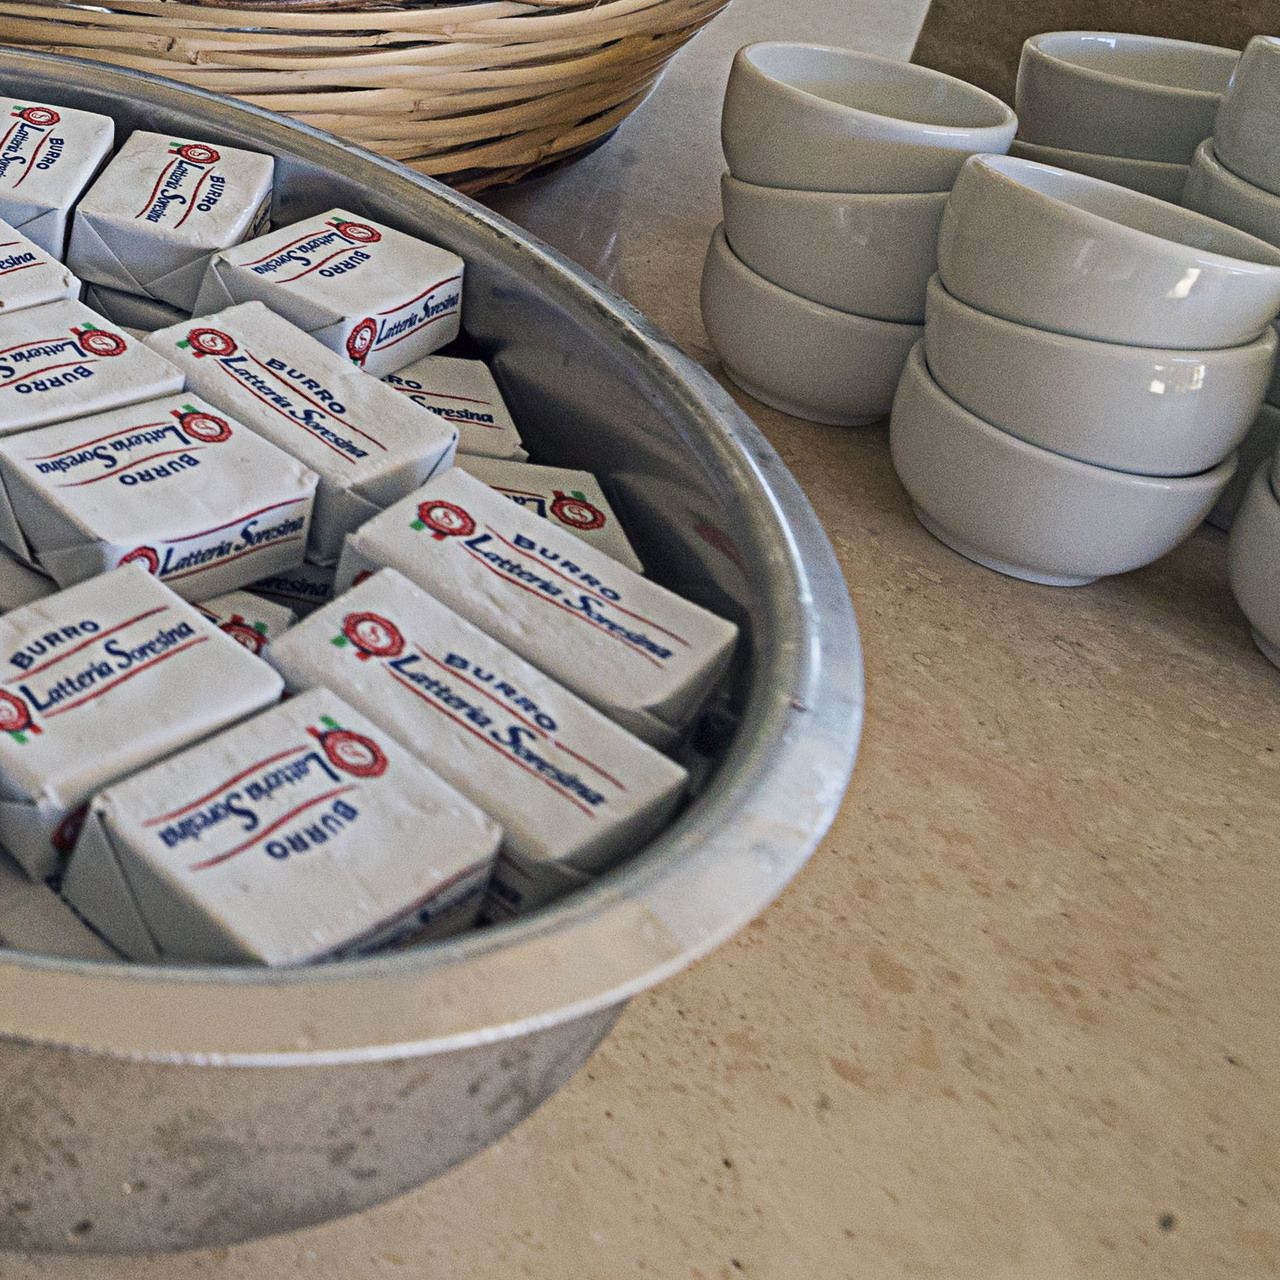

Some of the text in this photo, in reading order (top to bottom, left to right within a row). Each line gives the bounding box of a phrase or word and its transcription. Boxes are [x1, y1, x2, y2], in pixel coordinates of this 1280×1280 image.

[7, 123, 45, 155] Latteria
[35, 136, 65, 171] BURRO
[145, 158, 205, 223] Latteria Soresina
[196, 174, 225, 213] BURRO
[252, 228, 354, 274] Latteria Soresina
[318, 248, 372, 278] BURRO
[375, 290, 461, 345] Latteria Soresina
[11, 339, 87, 366] Latteria
[15, 365, 95, 394] BURRO
[220, 355, 368, 459] Latteria Soresina
[265, 357, 347, 415] BURRO
[36, 423, 191, 475] Latteria Soresina
[119, 453, 200, 486] BURRO
[158, 516, 305, 577] Latteria Soresina
[512, 533, 621, 602] BURRO
[464, 533, 673, 660] Latteria Soresina
[10, 619, 100, 670] BURRO
[19, 621, 195, 712] Latteria Soresina
[444, 653, 559, 733] BURRO
[389, 653, 606, 807] Latteria Soresina
[159, 751, 341, 849] Latteria Soresina
[266, 800, 360, 860] BURRO
